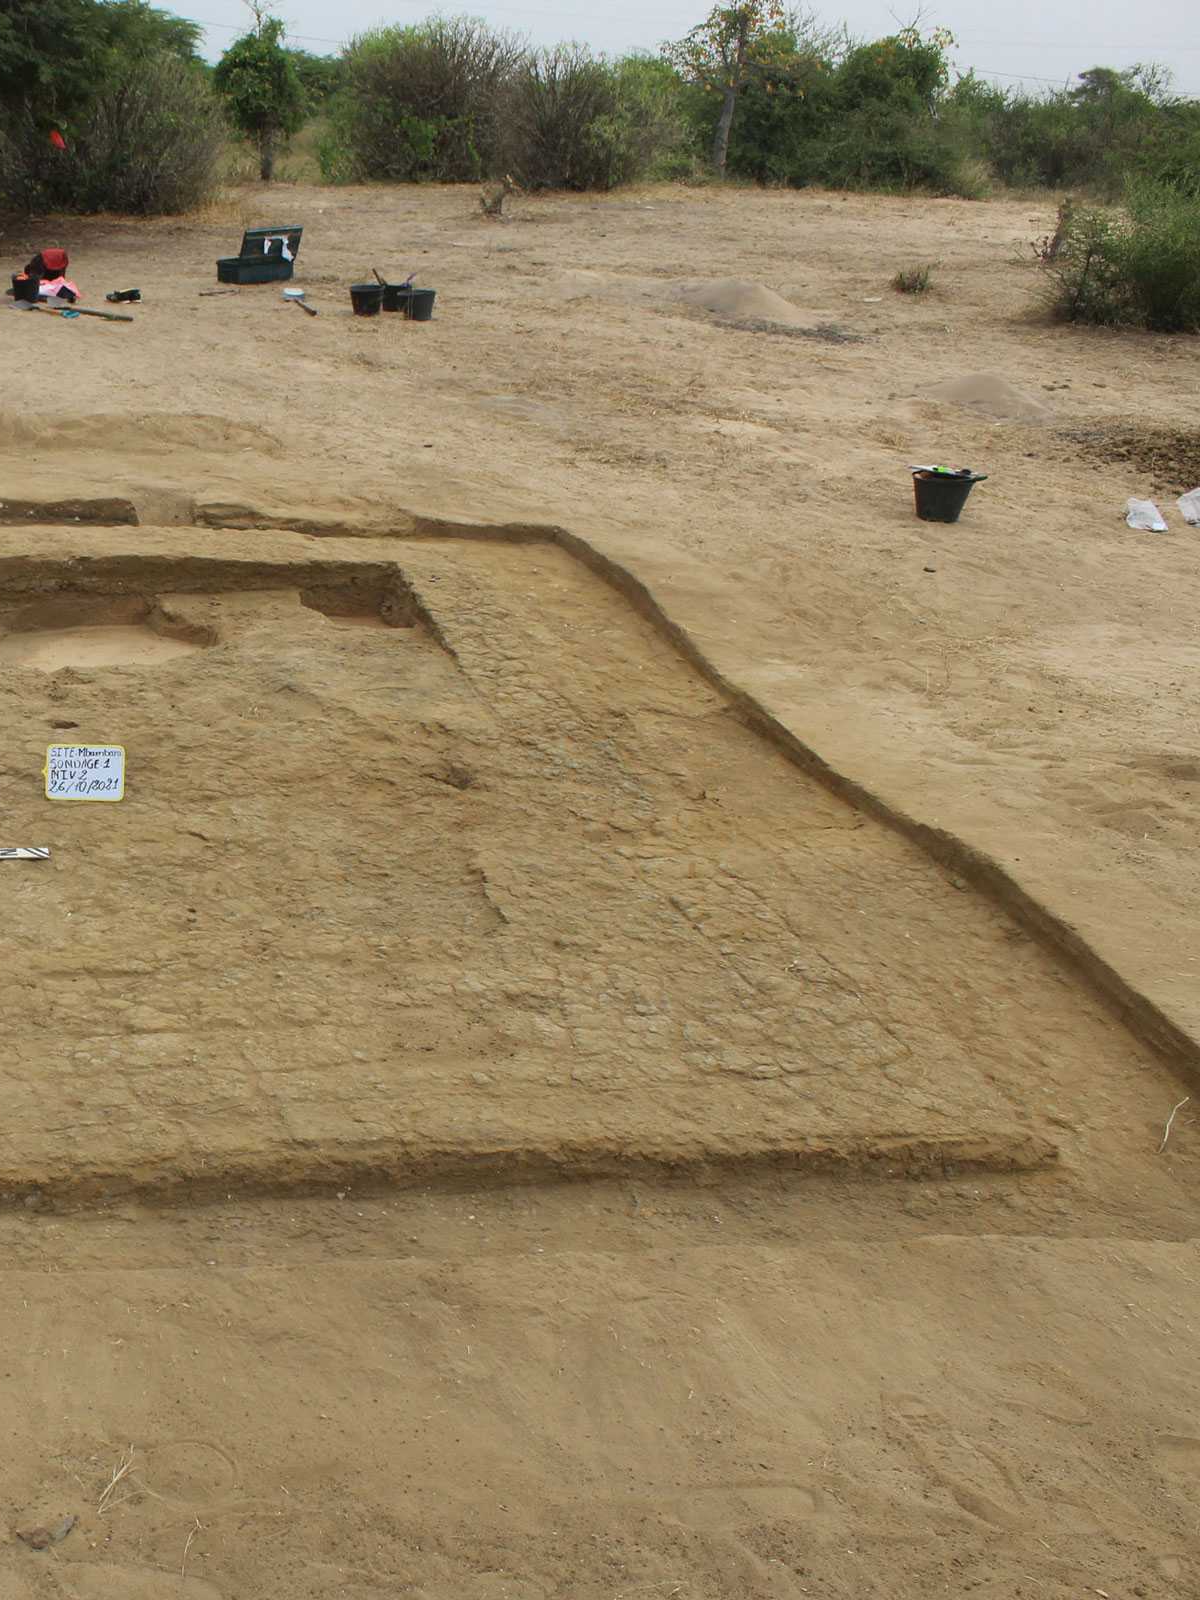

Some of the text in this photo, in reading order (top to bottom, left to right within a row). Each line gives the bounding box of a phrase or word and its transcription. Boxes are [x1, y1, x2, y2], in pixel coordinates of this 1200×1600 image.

[103, 758, 111, 769] 1
[51, 769, 88, 781] NIV 2
[48, 778, 119, 794] 26/10/2021
